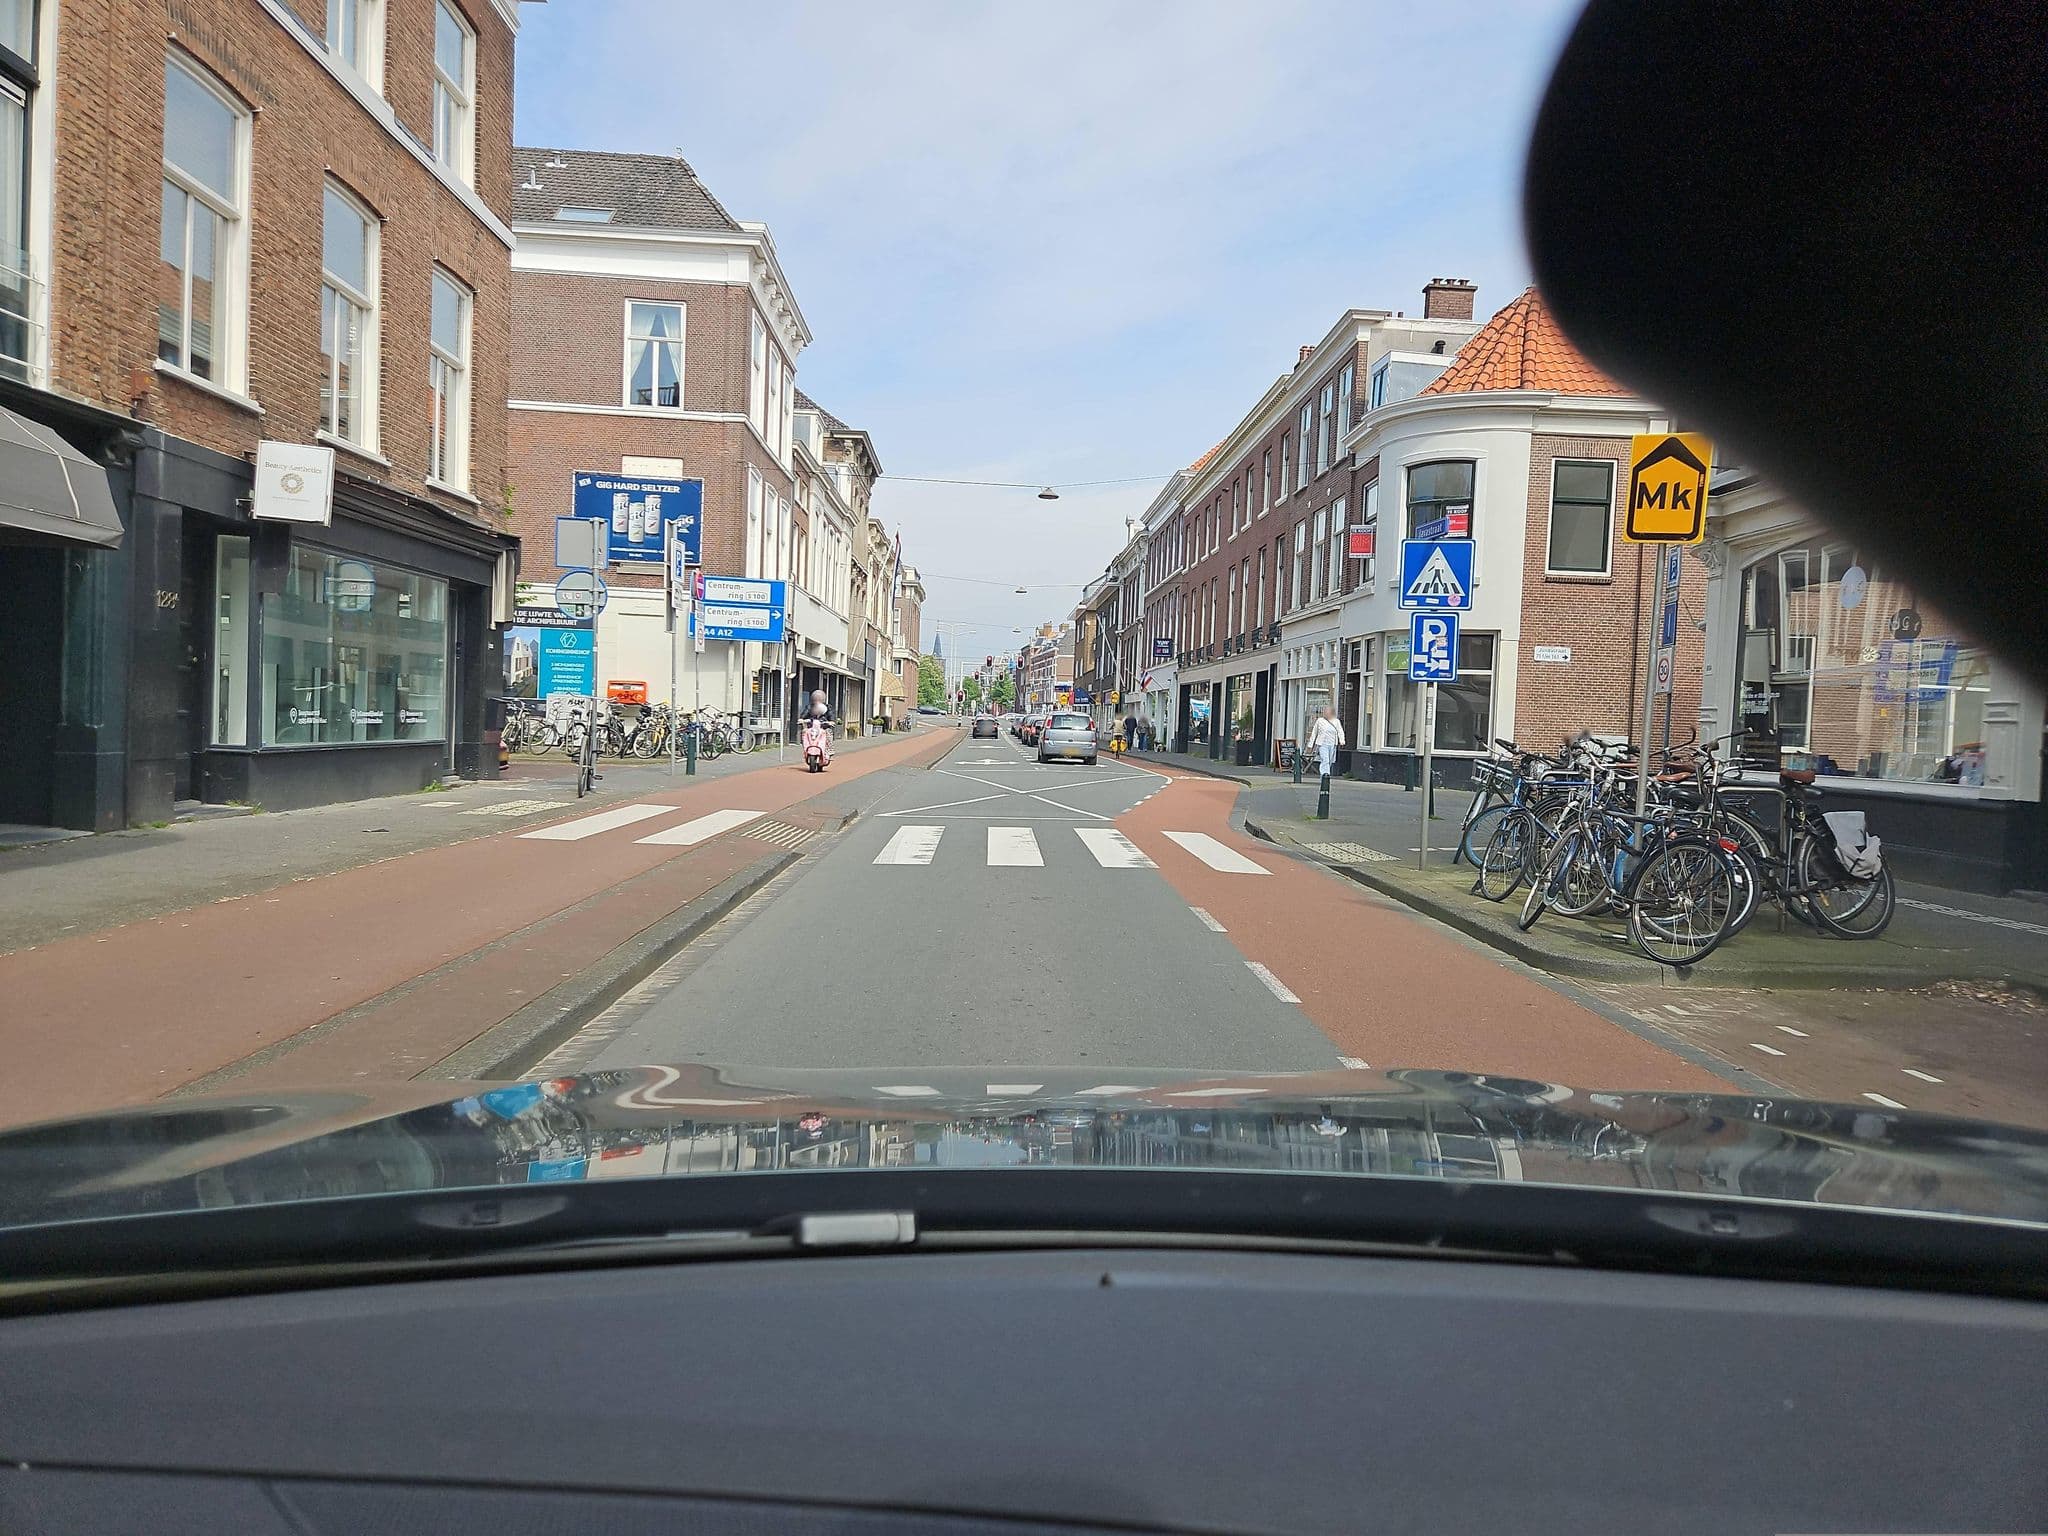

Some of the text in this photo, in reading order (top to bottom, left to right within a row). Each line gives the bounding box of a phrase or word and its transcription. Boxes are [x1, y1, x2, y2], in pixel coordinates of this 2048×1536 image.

[613, 482, 640, 490] HARD
[641, 483, 681, 493] SELTZER
[1636, 481, 1693, 510] Mk
[728, 592, 744, 600] ring
[727, 618, 743, 626] ring
[717, 629, 734, 637] A12
